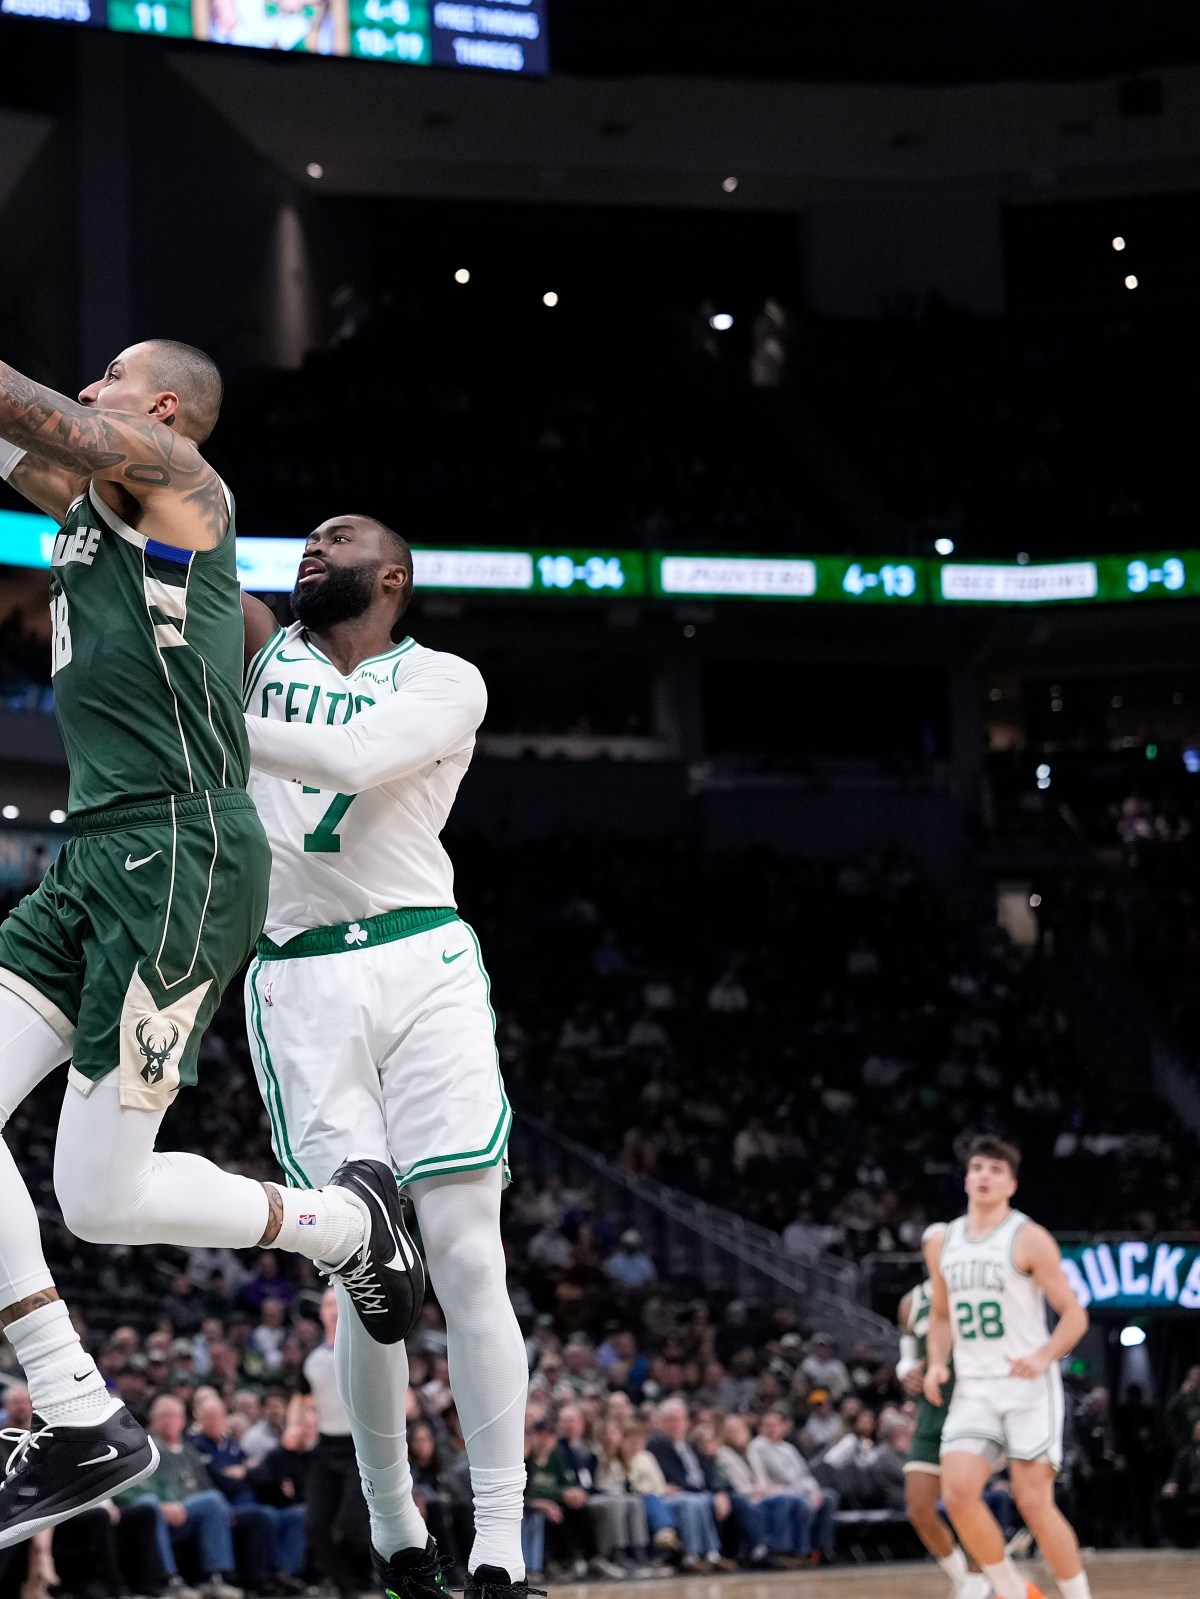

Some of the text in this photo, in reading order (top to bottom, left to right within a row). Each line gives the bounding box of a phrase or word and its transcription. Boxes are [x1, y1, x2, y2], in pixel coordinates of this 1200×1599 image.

[135, 2, 167, 32] 11
[842, 562, 916, 598] 4-13
[1126, 557, 1186, 593] 3-3
[261, 681, 377, 726] CELTI
[302, 785, 358, 853] 7
[956, 1301, 1005, 1339] 28
